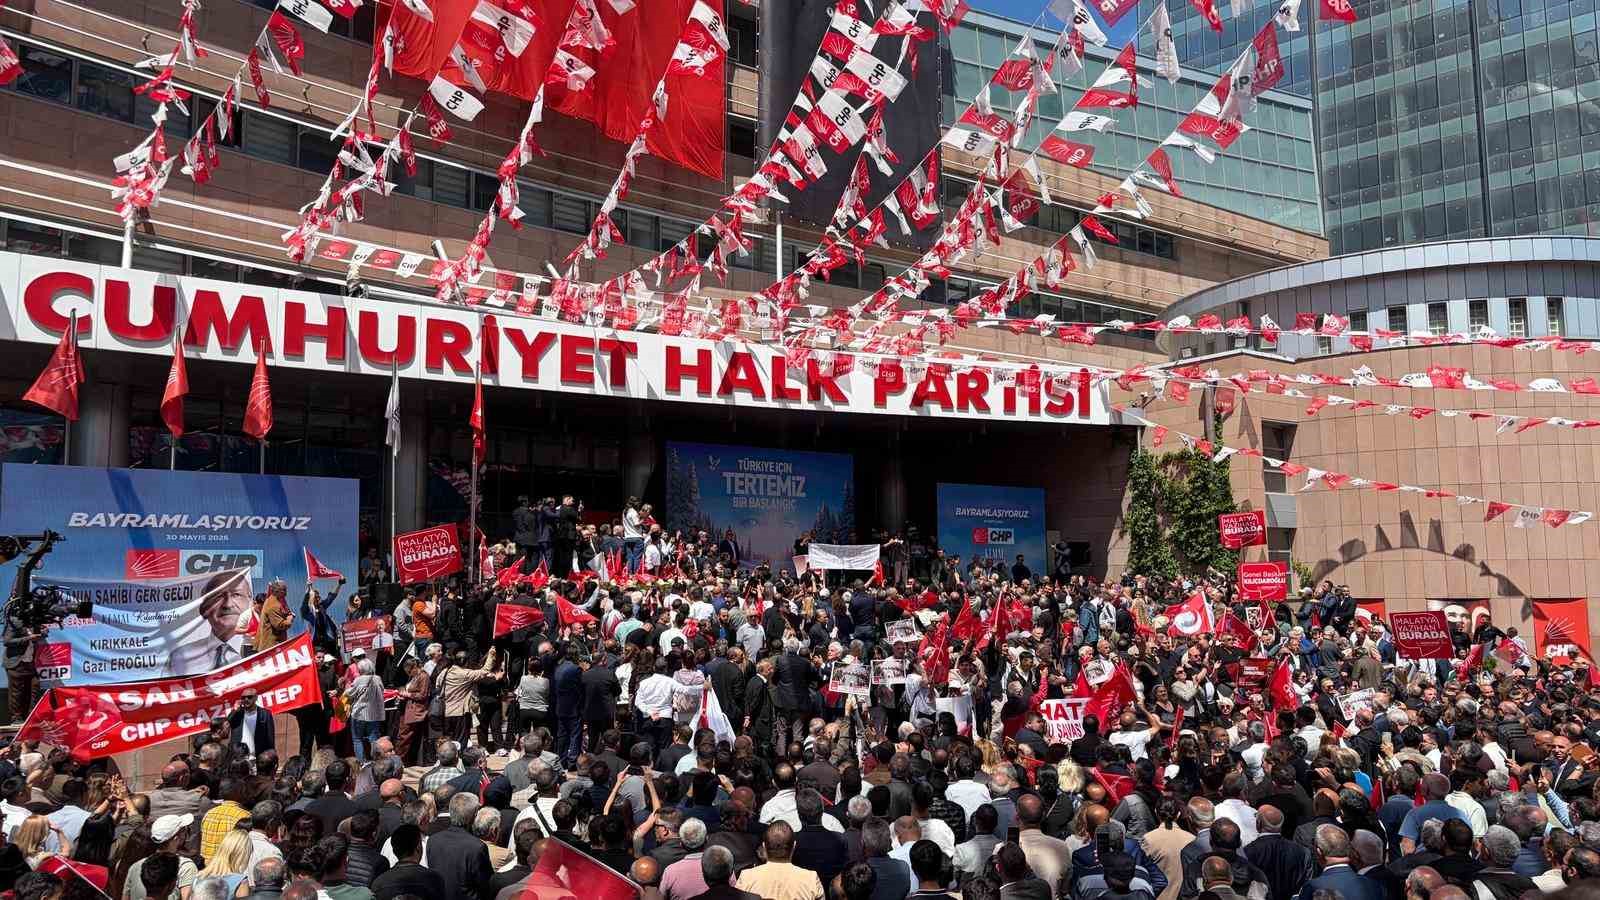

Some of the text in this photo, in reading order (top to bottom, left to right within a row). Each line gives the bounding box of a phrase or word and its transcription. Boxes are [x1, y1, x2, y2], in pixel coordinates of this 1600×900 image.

[823, 68, 837, 88] CHP
[868, 63, 887, 86] CHP
[446, 90, 465, 110] CHP
[835, 106, 852, 127] CHP
[429, 119, 448, 138] CHP
[991, 119, 1009, 134] CHP
[964, 132, 982, 151] CHP
[24, 271, 638, 387] CUMHURİYET
[665, 345, 849, 405] HALK
[722, 471, 807, 498] TERTEMİZ
[68, 512, 312, 531] BAYRAMLAŞIYORUZ
[1224, 525, 1263, 535] BURADA
[401, 532, 448, 548] MALATYA
[990, 530, 1013, 542] CHP
[402, 540, 446, 555] YAZIHAN
[404, 545, 458, 565] BURADA
[185, 553, 257, 574] CHP
[96, 585, 132, 605] SAHİBİ
[136, 585, 160, 603] GERİ
[163, 583, 194, 601] GELDİ
[1395, 616, 1437, 626] MALATYA
[1398, 624, 1437, 632] YAZIHAN
[90, 636, 149, 651] KIRIKKALE
[1400, 631, 1448, 640] BURADA
[83, 657, 157, 673] Gazi EROĞLU
[121, 718, 172, 742] CHP
[91, 740, 110, 750] CHP
